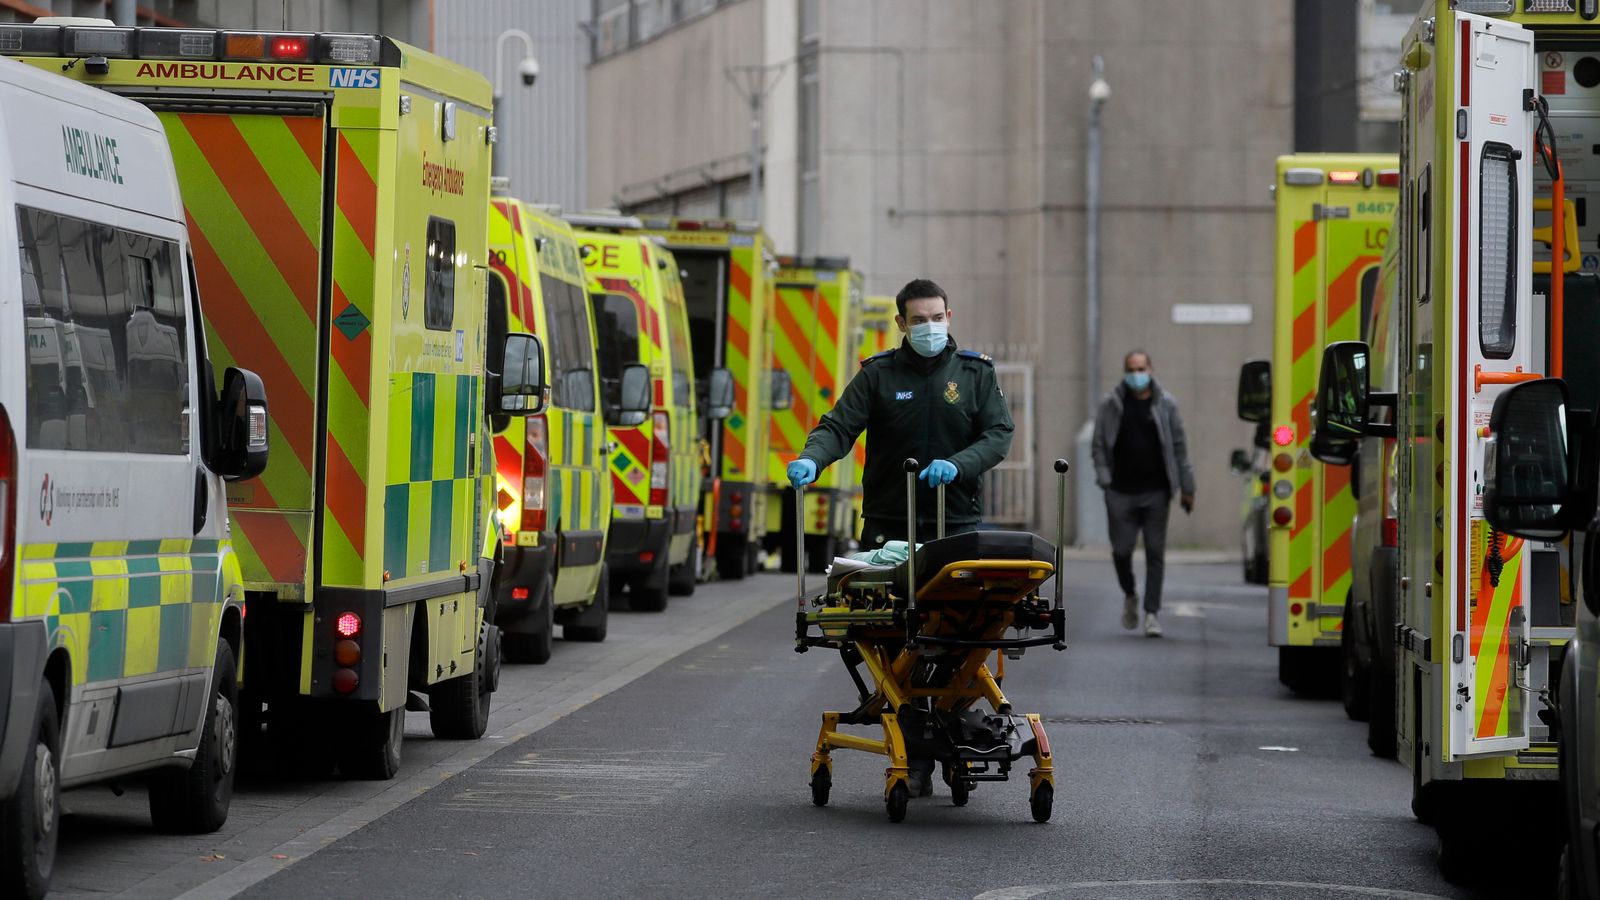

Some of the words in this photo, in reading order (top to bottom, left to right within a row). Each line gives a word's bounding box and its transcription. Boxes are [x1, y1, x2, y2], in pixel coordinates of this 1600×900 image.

[136, 63, 315, 81] AMBULANCE
[330, 68, 379, 88] NHS
[61, 124, 124, 185] AMBULANCE
[896, 391, 914, 400] NHS
